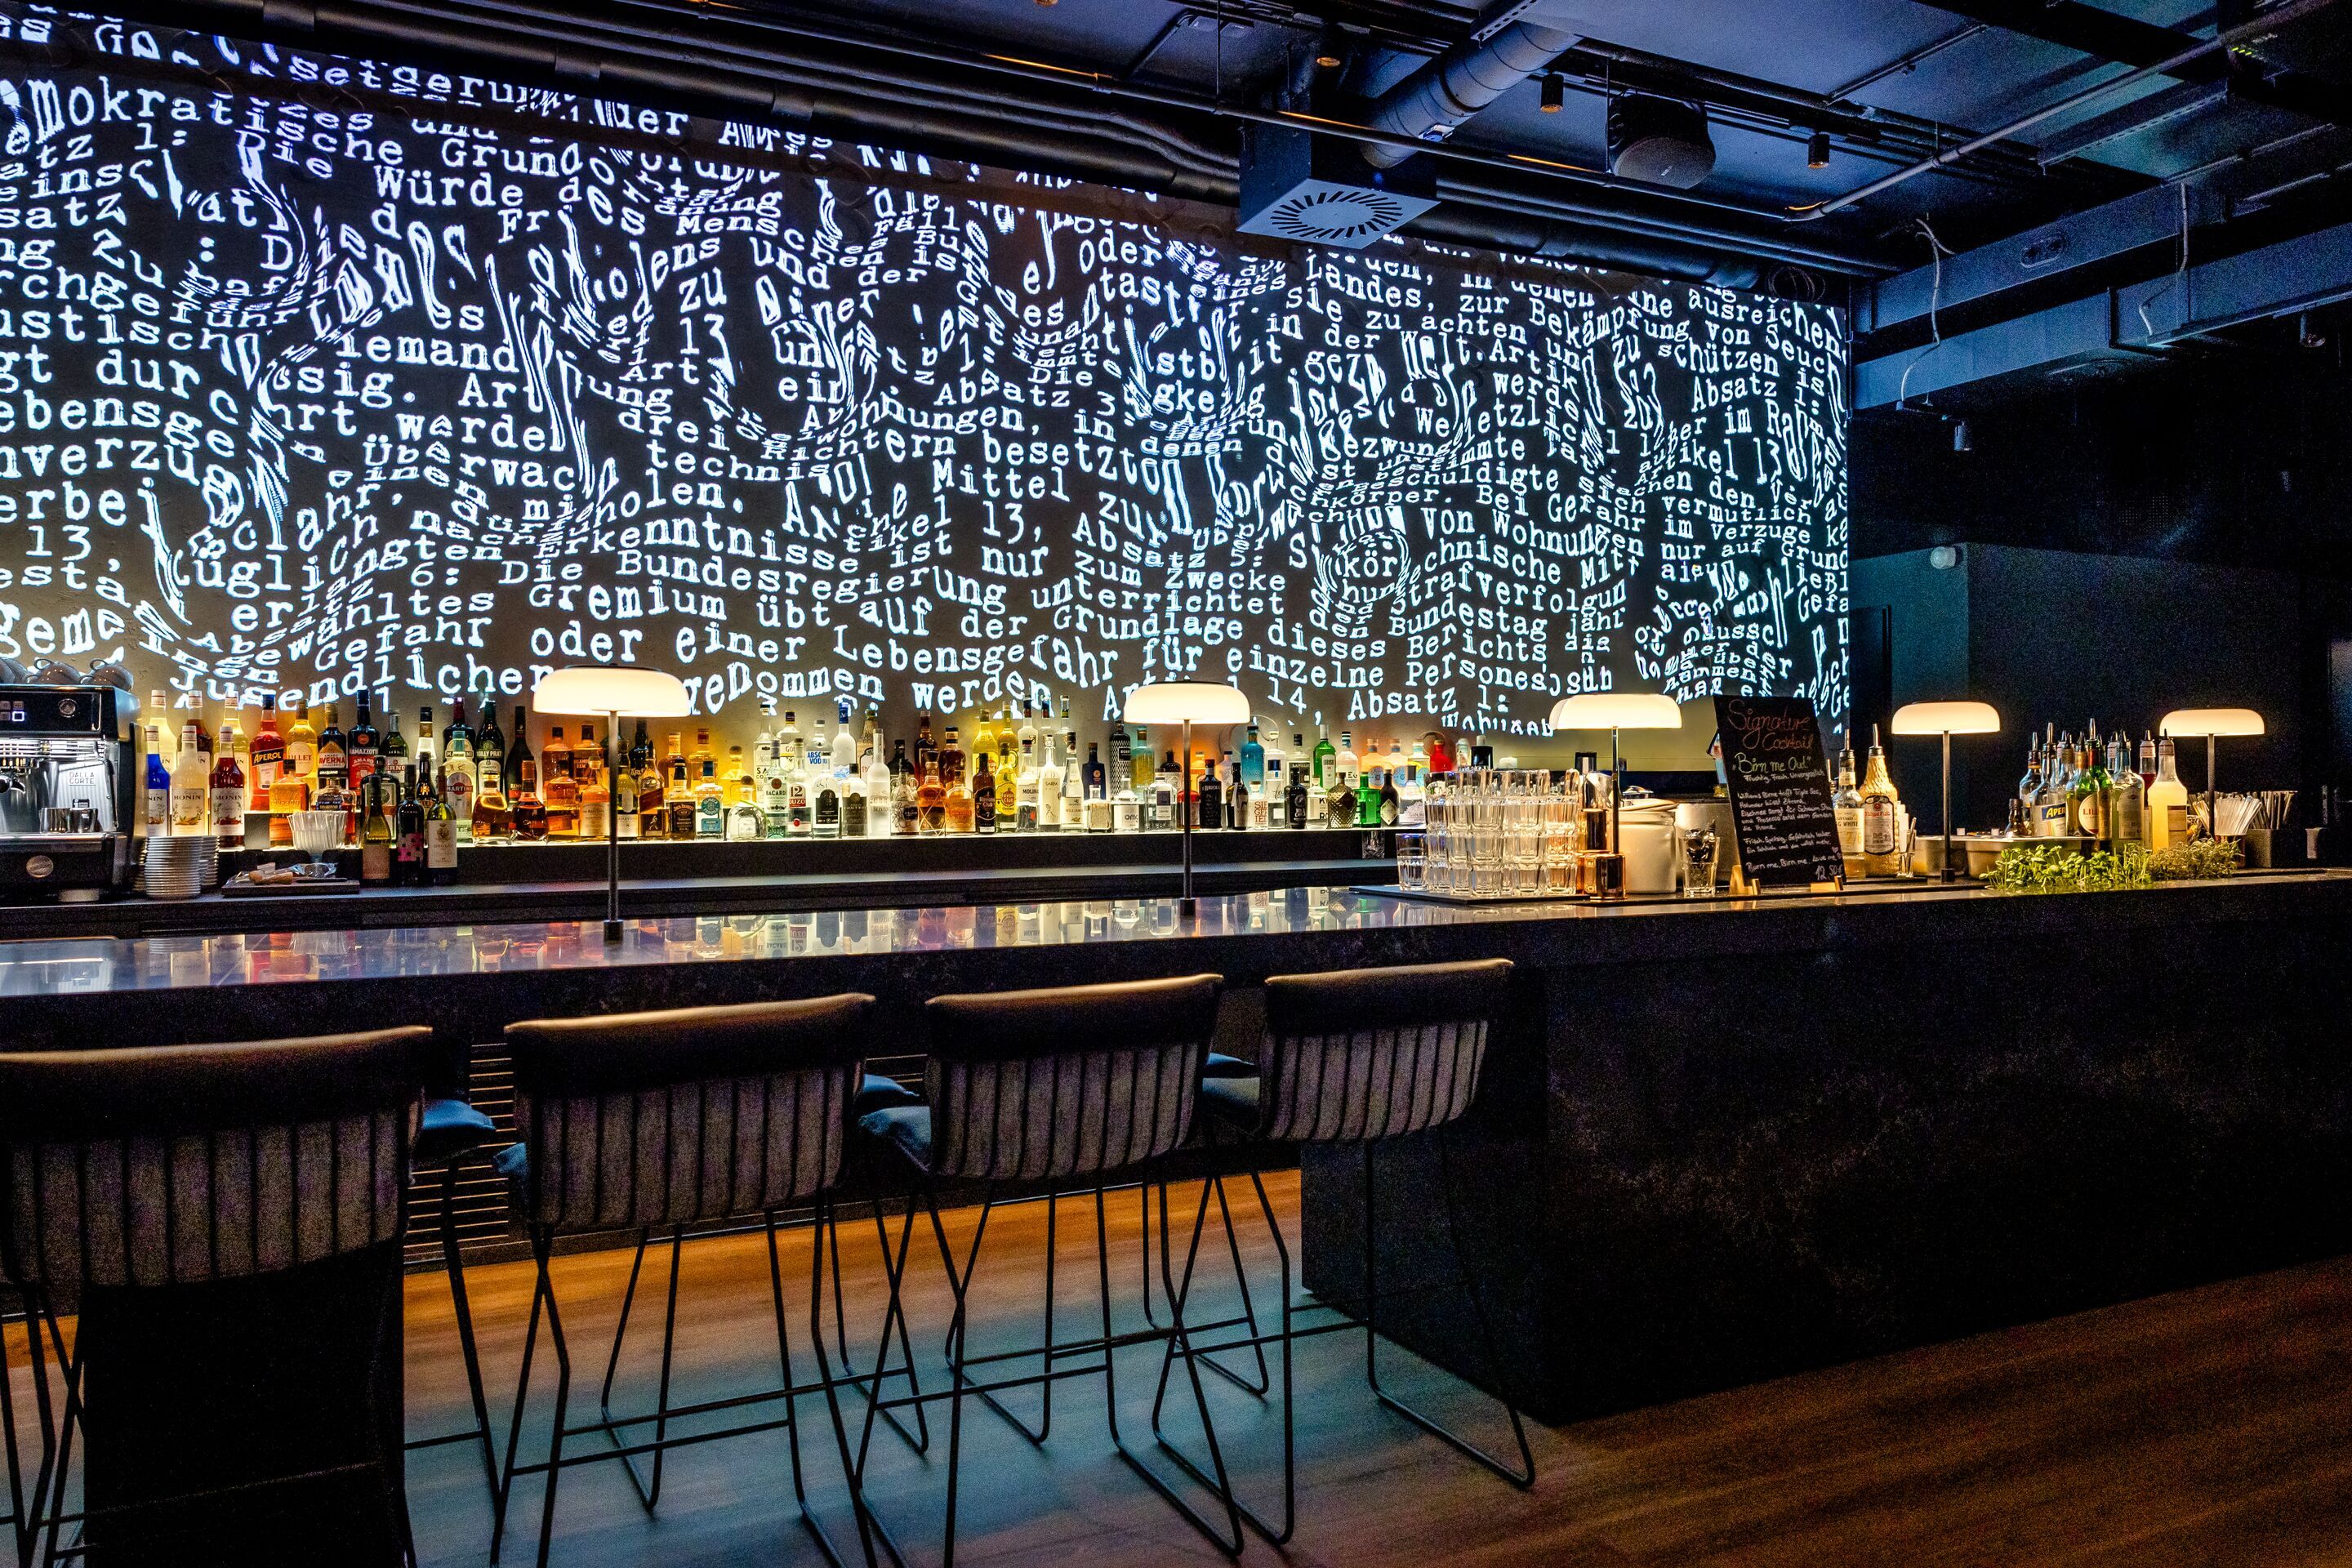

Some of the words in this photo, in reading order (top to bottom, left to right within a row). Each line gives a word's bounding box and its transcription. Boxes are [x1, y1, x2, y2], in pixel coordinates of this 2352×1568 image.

[375, 164, 523, 207] Würde
[1366, 310, 1402, 330] zu
[1421, 313, 1528, 345] achten
[1460, 293, 1510, 314] zur
[1705, 319, 1751, 345] von
[1325, 323, 1381, 350] der
[1690, 373, 1778, 412] Absatz
[933, 457, 1071, 503] Mittel
[1661, 541, 1706, 560] nur
[1720, 538, 1765, 558] auf
[982, 500, 1042, 545] 13,
[1476, 484, 1530, 517] Bei
[1663, 514, 1695, 539] im
[1712, 522, 1812, 545] Verzuge
[981, 546, 1049, 578] nur
[1075, 550, 1143, 588] zum
[1165, 567, 1287, 592] Zwecke
[498, 560, 584, 585] Die
[1031, 572, 1286, 615] unterrichtet
[1388, 592, 1548, 642] Bundestag
[528, 580, 728, 621] Gremium
[756, 594, 831, 629] übt
[858, 595, 933, 637] auf
[960, 608, 1029, 640] der
[1053, 604, 1245, 645] Grundlage
[1267, 617, 1387, 662] dieses
[1405, 621, 1548, 663] Berichts
[530, 621, 644, 663] oder
[676, 621, 808, 664] einer
[1142, 635, 1204, 672] für
[1226, 645, 1385, 689] einzelne
[1348, 688, 1457, 721] Absatz
[253, 751, 283, 763] APEROL
[1770, 760, 1786, 772] me
[791, 786, 803, 797] 12
[2046, 804, 2066, 818] APER
